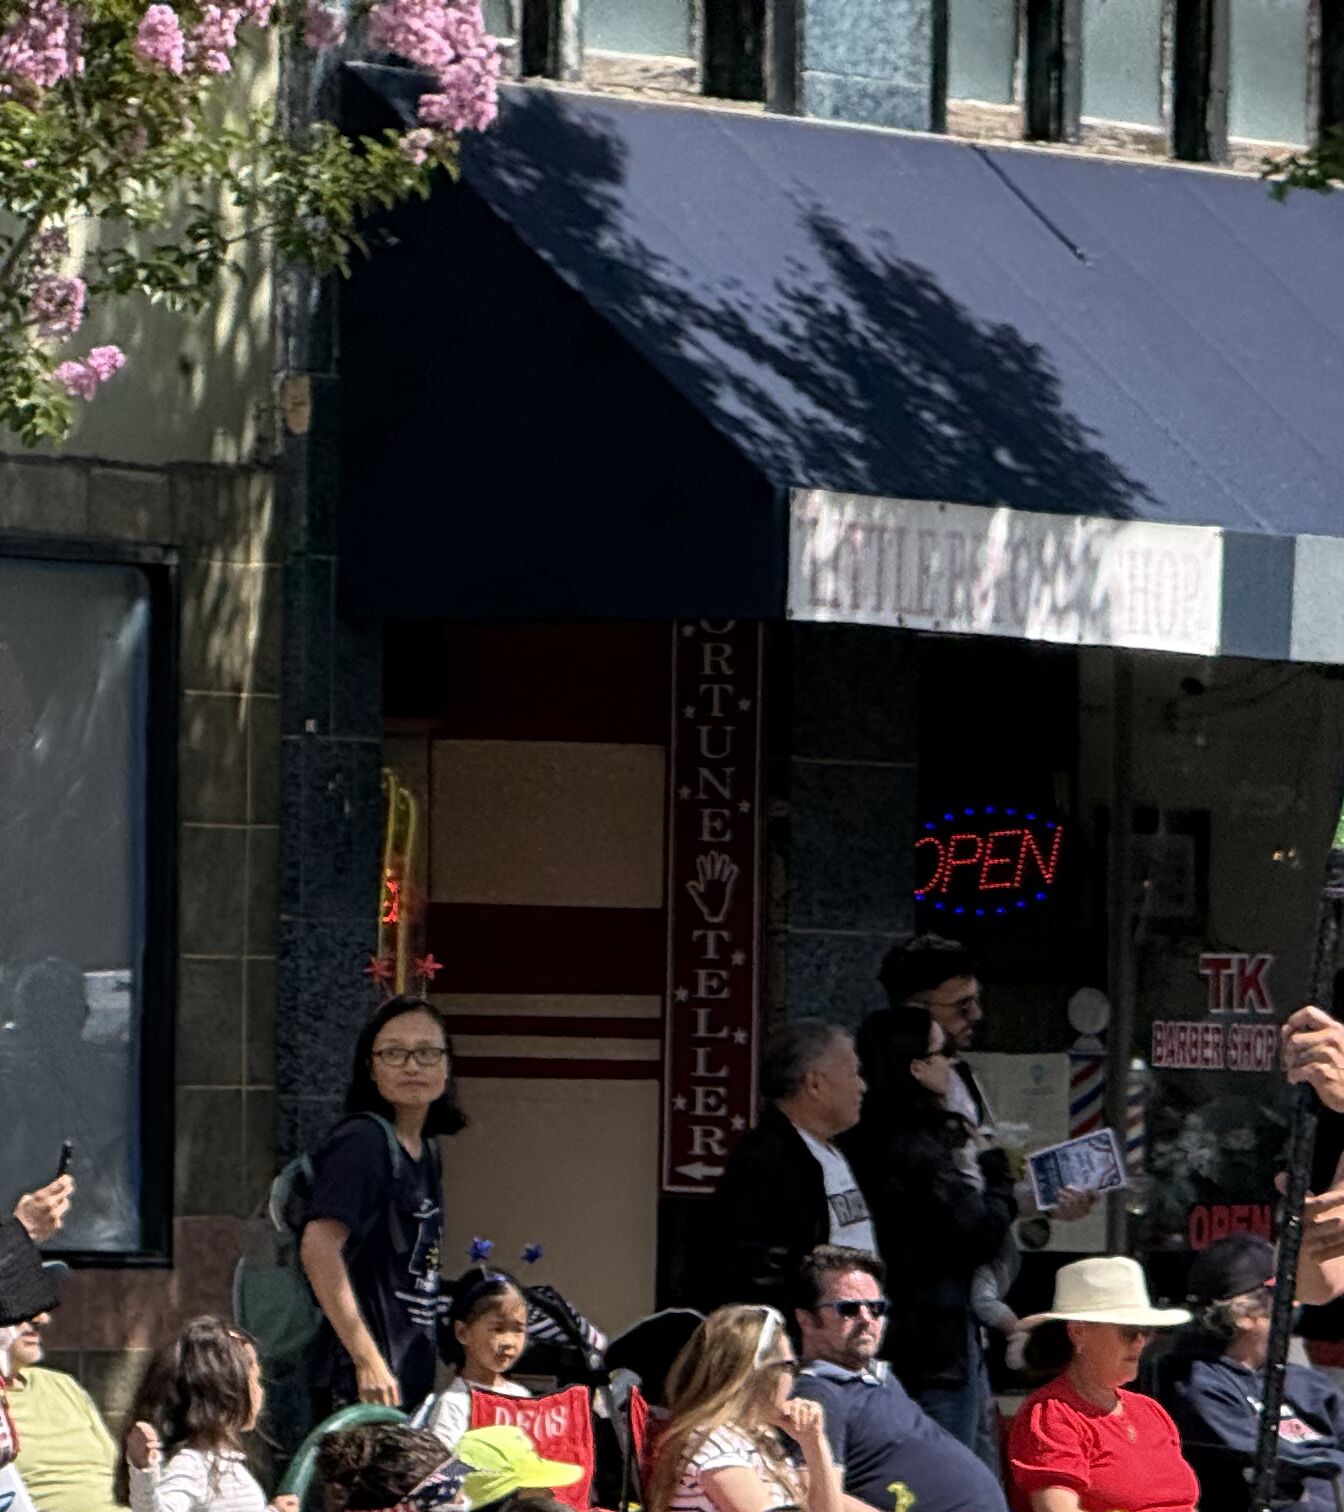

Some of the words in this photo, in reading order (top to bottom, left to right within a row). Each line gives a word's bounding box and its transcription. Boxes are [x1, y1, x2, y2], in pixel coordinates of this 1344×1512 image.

[914, 825, 1063, 894] OPEN
[1200, 953, 1274, 1014] TK
[689, 929, 732, 1156] TELLER
[1151, 1020, 1225, 1069] BARBER
[1227, 1023, 1277, 1071] SHOP
[1188, 1203, 1273, 1251] OPEN
